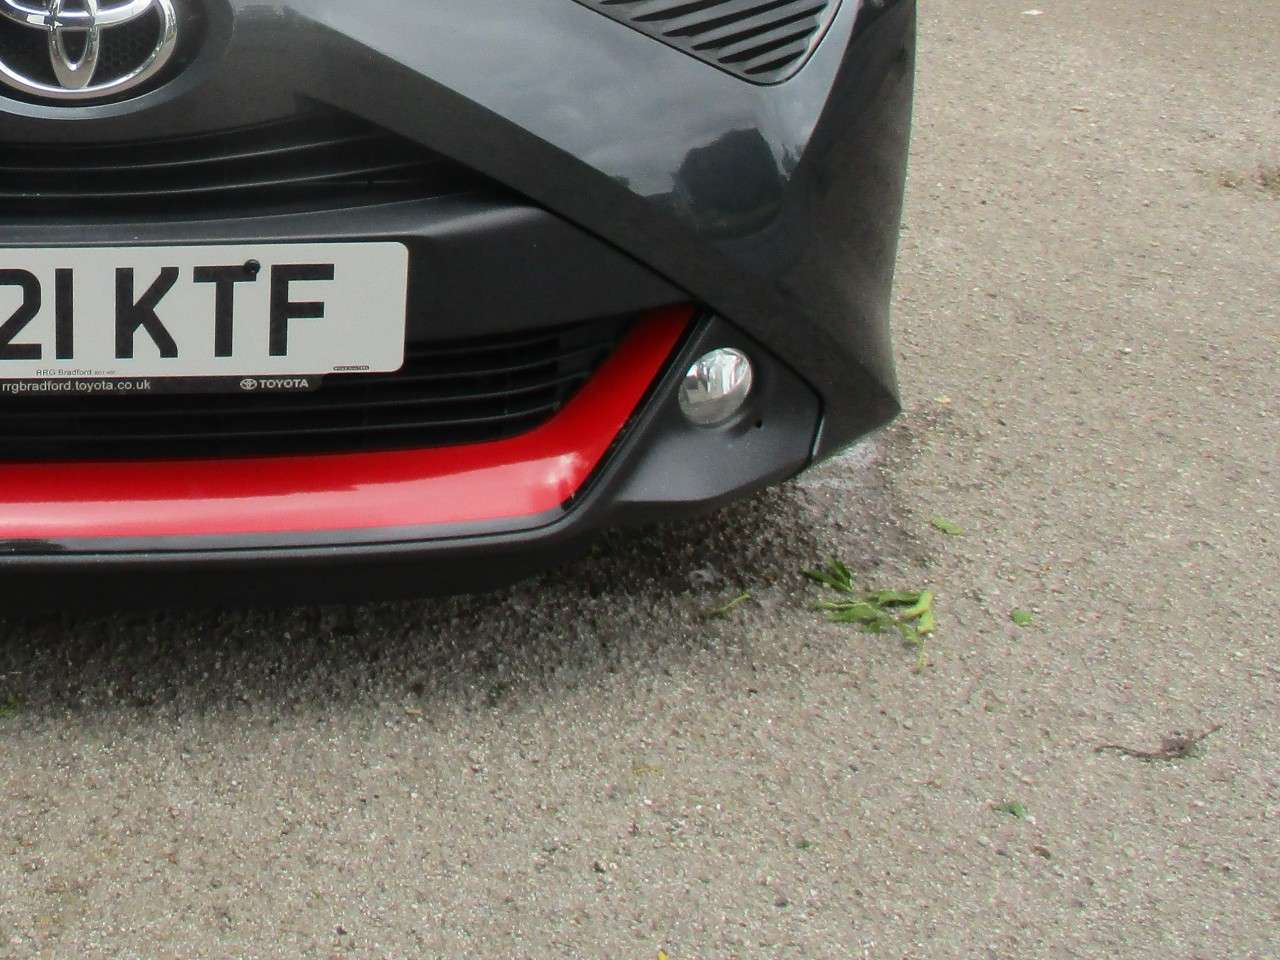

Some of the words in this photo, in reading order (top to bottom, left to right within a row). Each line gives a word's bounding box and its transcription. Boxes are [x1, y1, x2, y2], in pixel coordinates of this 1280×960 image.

[114, 263, 335, 359] KTF
[58, 368, 92, 376] Bradford
[2, 379, 151, 394] rrgbradford.toyota.co.uk
[259, 378, 309, 389] TOYOTA
